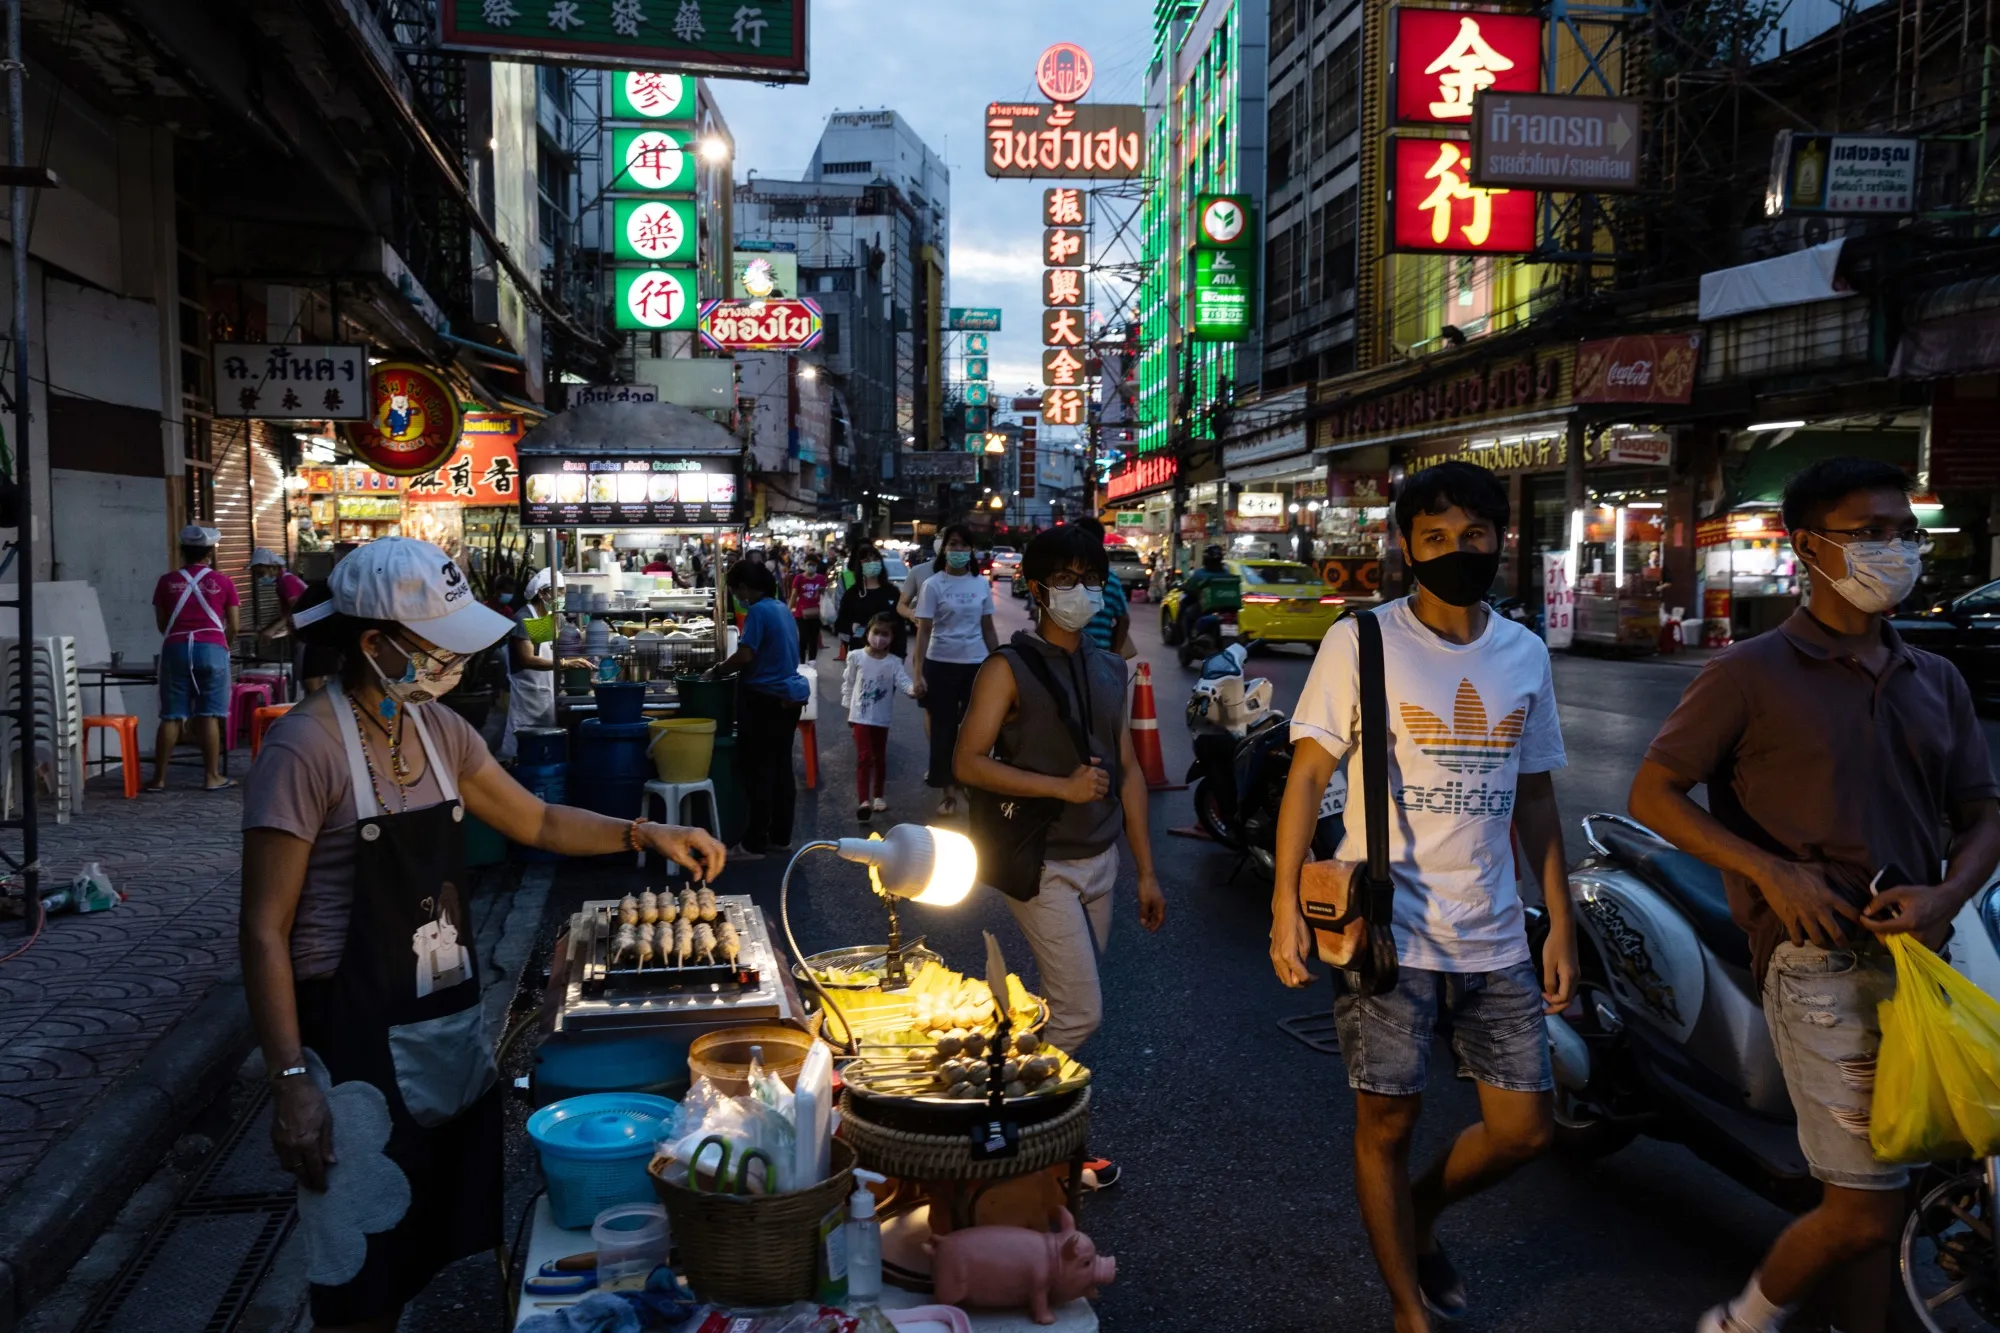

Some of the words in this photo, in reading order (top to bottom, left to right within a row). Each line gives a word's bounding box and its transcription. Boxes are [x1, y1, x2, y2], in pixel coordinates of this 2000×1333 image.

[1418, 17, 1514, 245] 金行
[1491, 100, 1602, 147] ที่จอดรถ
[1834, 146, 1909, 166] แสงอรุณ
[1212, 274, 1236, 285] ATM
[1047, 188, 1083, 424] 振和興大金行
[712, 306, 810, 342] ทองใบ
[1613, 431, 1669, 454] ที่จอดรถ
[1396, 781, 1513, 816] adidas
